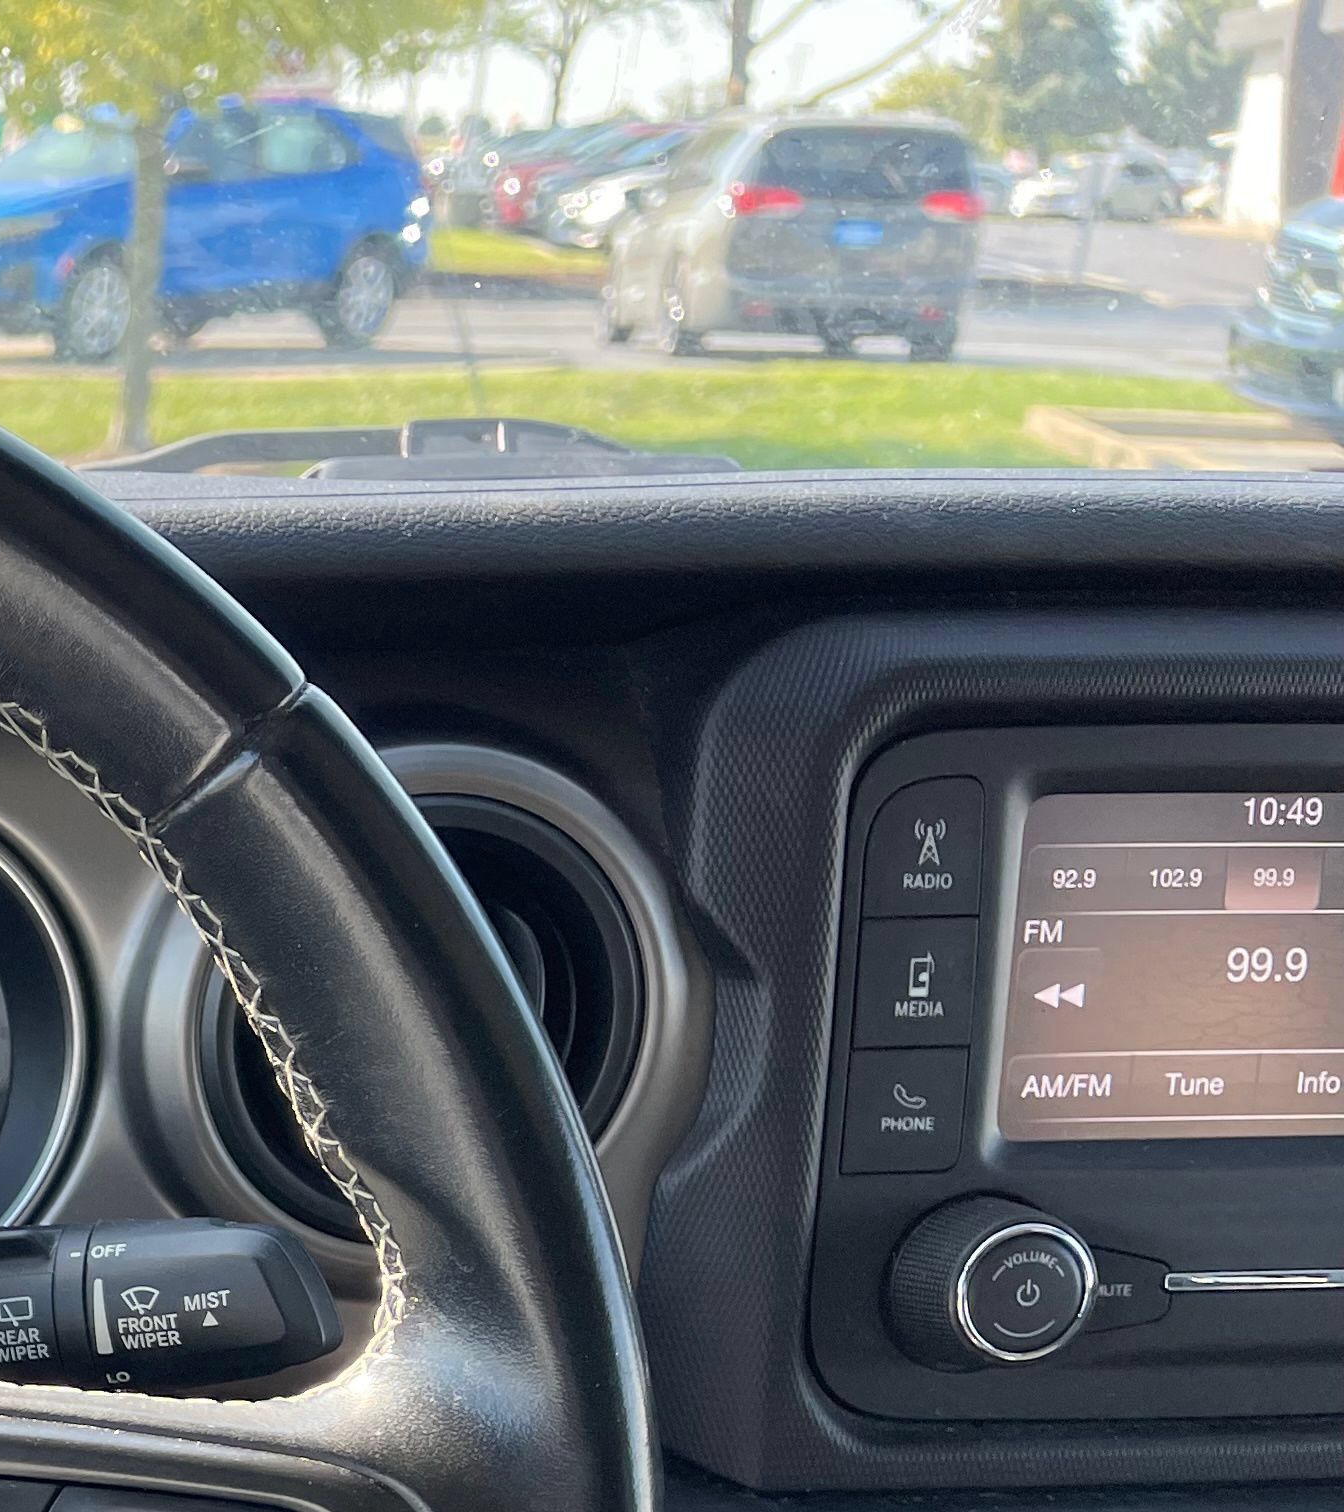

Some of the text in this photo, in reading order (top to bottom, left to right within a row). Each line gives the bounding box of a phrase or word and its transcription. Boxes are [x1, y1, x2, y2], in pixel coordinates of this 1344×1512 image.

[1243, 798, 1324, 826] 10:49
[903, 872, 953, 891] RADIO
[1052, 868, 1295, 890] 92.9 102.9 99.9
[1023, 919, 1063, 944] FM
[1226, 947, 1309, 984] 99.9
[894, 1000, 944, 1018] MEDIA
[1021, 1071, 1341, 1098] AM/FM Tune Info
[881, 1116, 935, 1132] PHONE
[91, 1242, 127, 1259] OFF
[1003, 1250, 1058, 1269] VOLUME
[183, 1289, 231, 1313] MIST
[117, 1314, 177, 1334] FRONT
[121, 1330, 182, 1350] WIPER
[106, 1370, 131, 1385] LO
